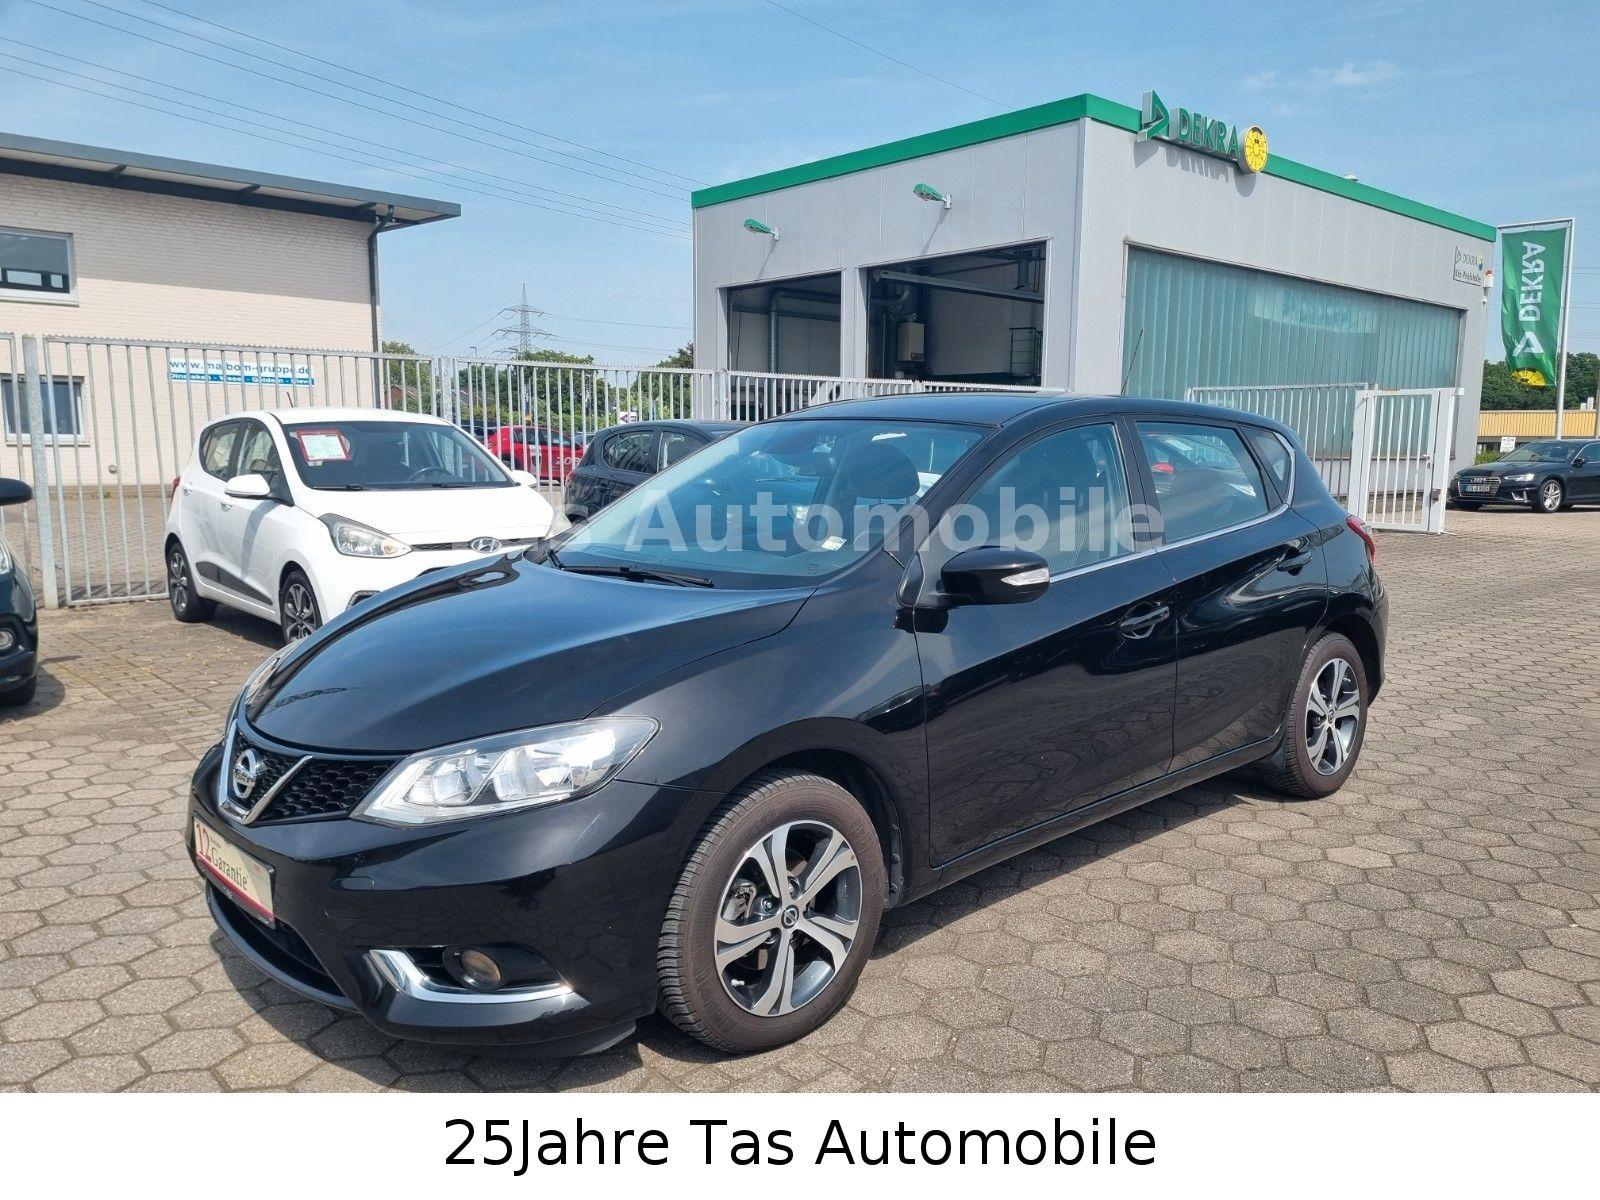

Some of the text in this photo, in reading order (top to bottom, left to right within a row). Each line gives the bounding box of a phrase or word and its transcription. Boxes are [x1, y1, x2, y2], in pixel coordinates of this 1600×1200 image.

[1178, 107, 1241, 160] DEKRA
[1518, 241, 1546, 322] DEKRA
[211, 846, 248, 891] Garantie
